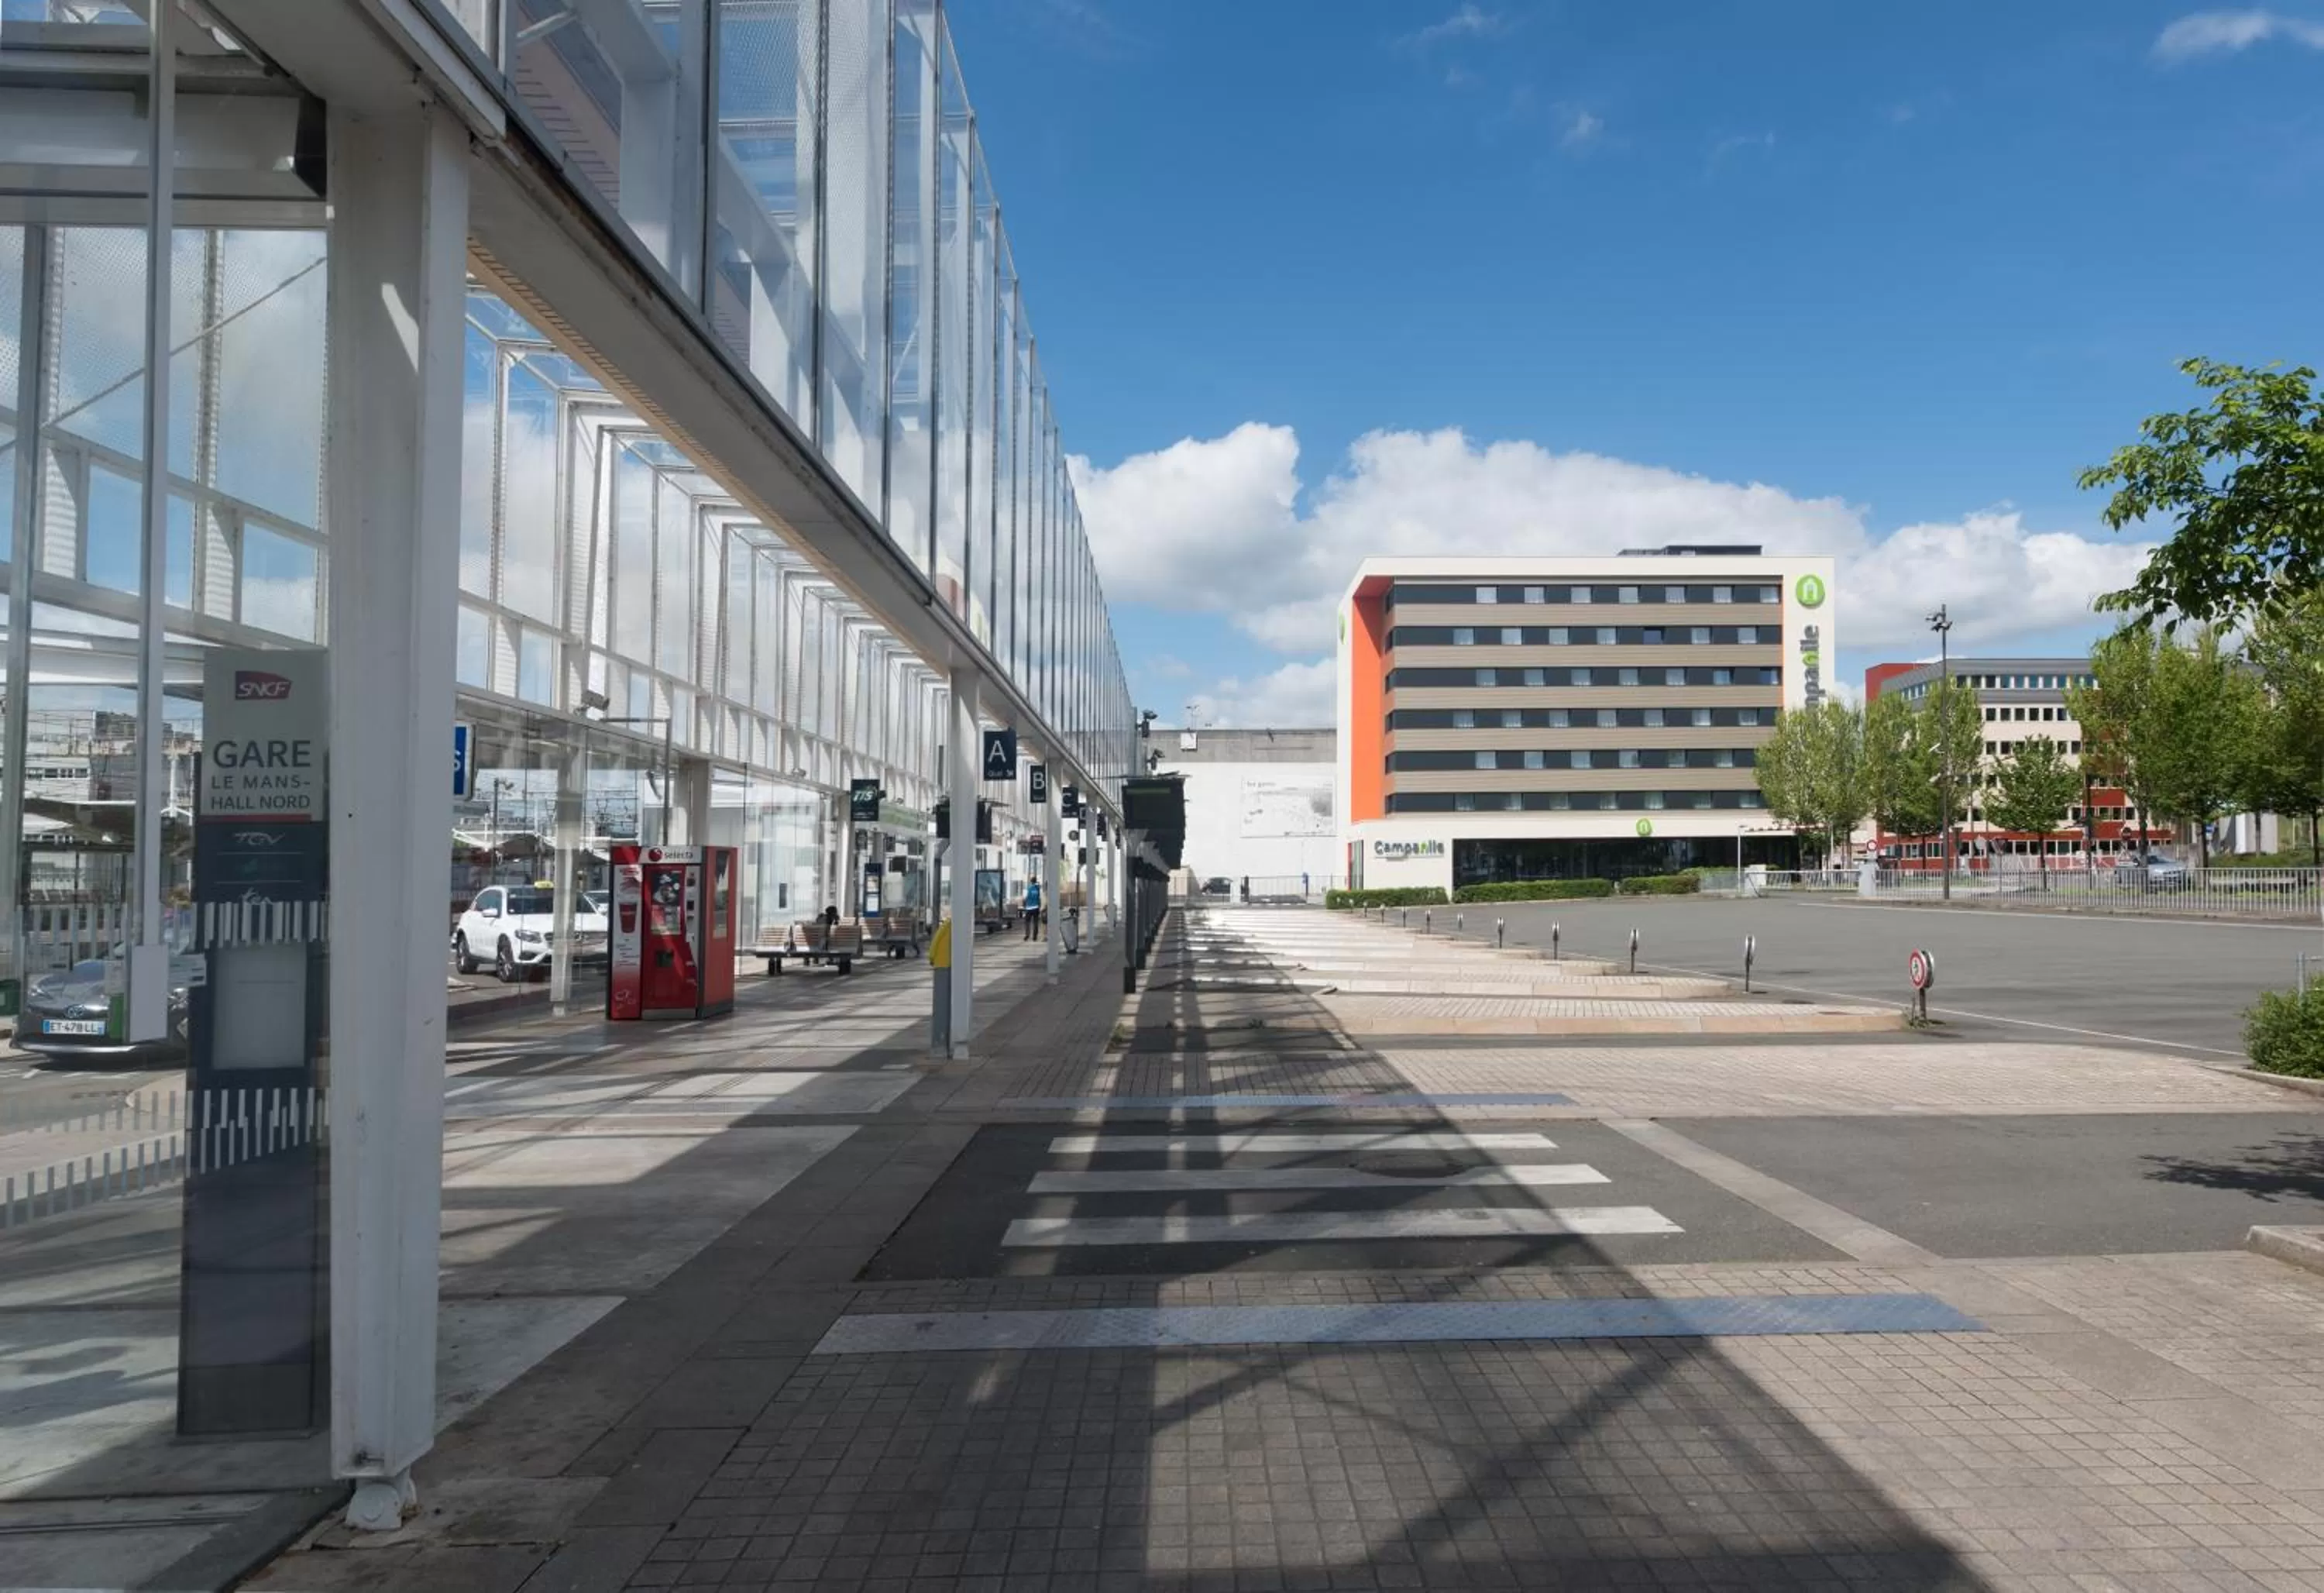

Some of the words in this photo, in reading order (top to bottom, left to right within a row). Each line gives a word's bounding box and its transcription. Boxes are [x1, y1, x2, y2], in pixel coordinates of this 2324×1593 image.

[237, 681, 290, 697] SNCF
[213, 740, 311, 769] GARE
[988, 739, 1006, 762] A
[211, 776, 234, 790] LE
[243, 775, 311, 789] MANS-
[1033, 772, 1045, 790] B
[211, 796, 256, 810] HALL
[260, 795, 311, 809] NORD
[234, 831, 286, 846] TGV
[664, 850, 693, 859] selecta
[1374, 839, 1445, 857] Campanile
